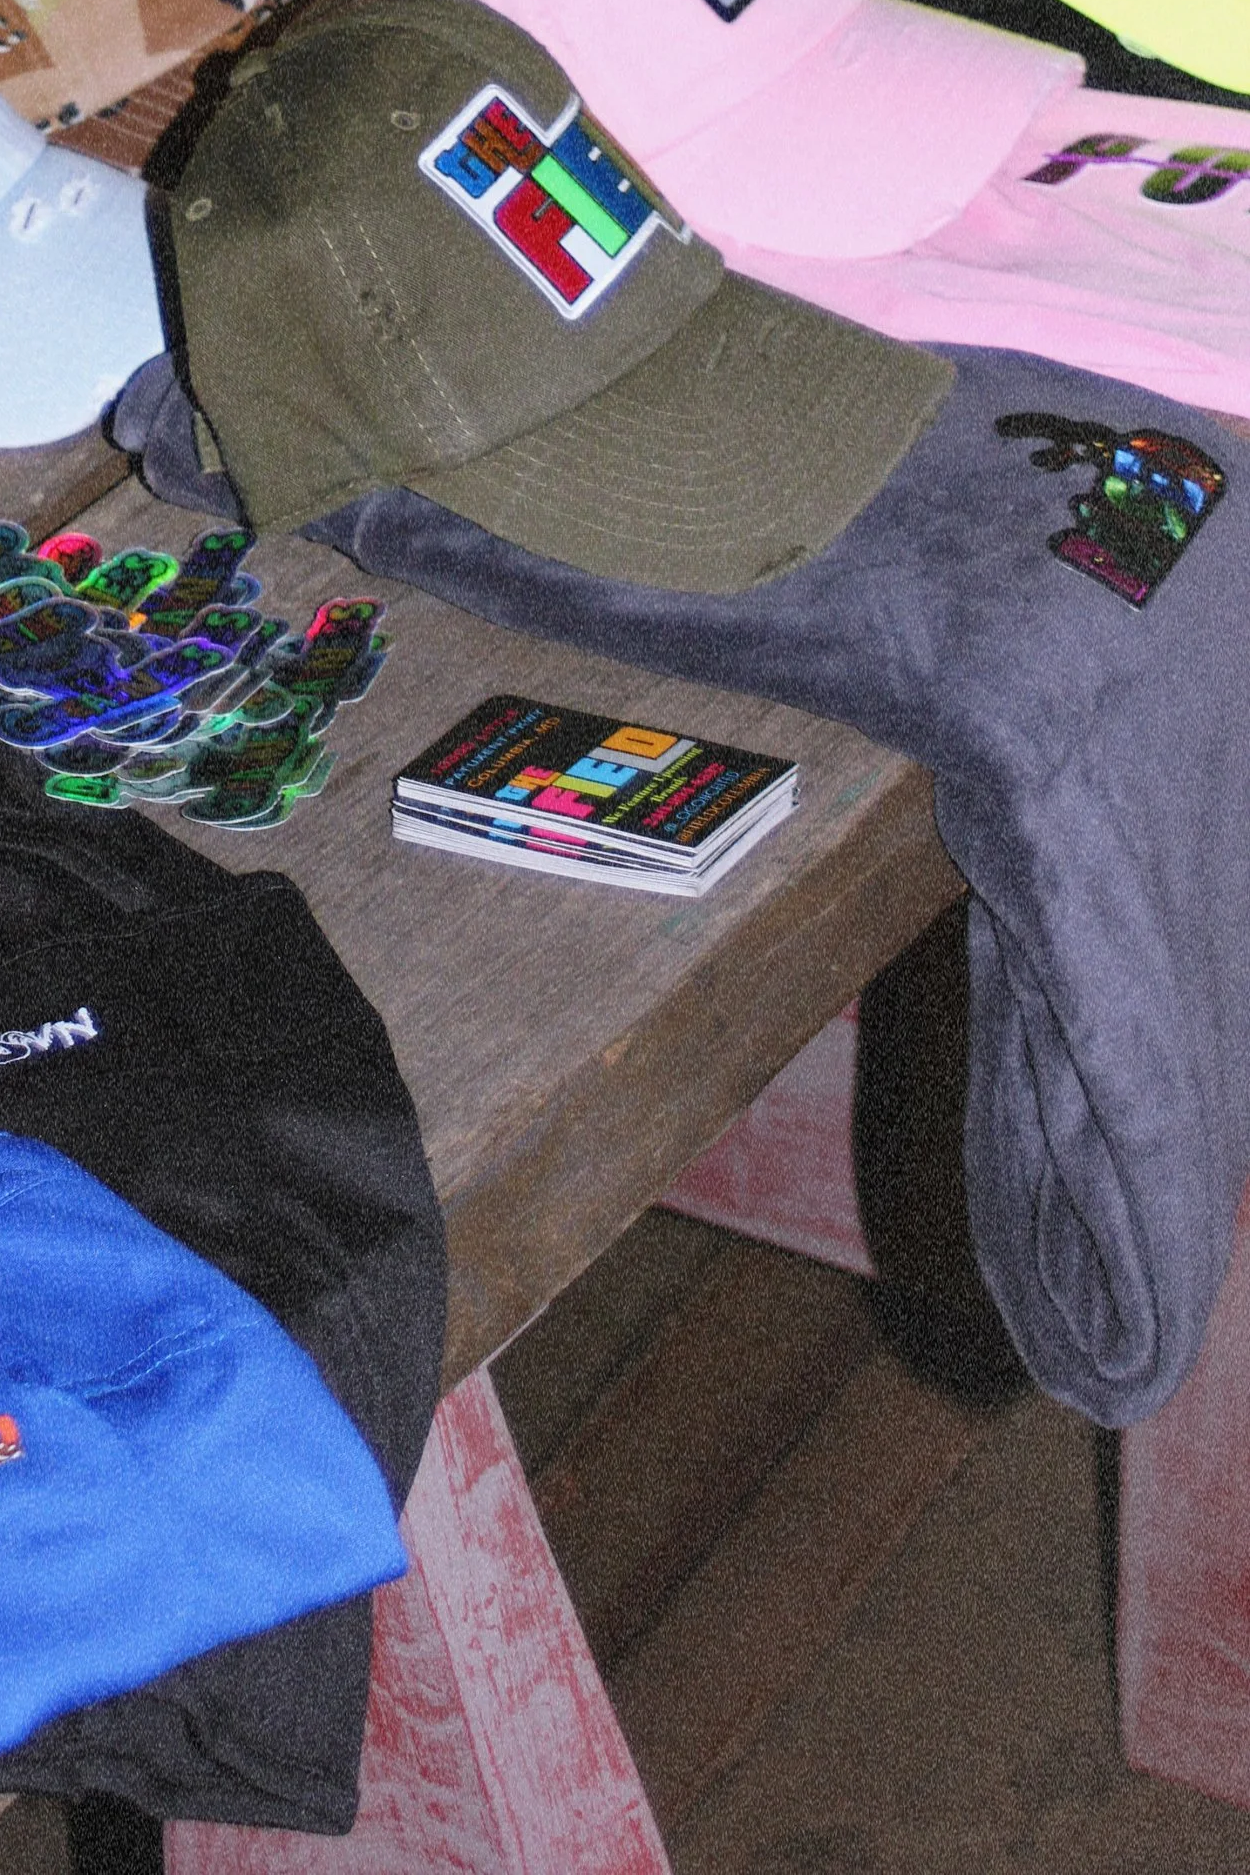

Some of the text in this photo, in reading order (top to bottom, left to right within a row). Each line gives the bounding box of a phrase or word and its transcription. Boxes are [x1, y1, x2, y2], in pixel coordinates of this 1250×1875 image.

[434, 97, 543, 199] THE
[495, 764, 562, 801] THE
[531, 725, 698, 819] FIELD
